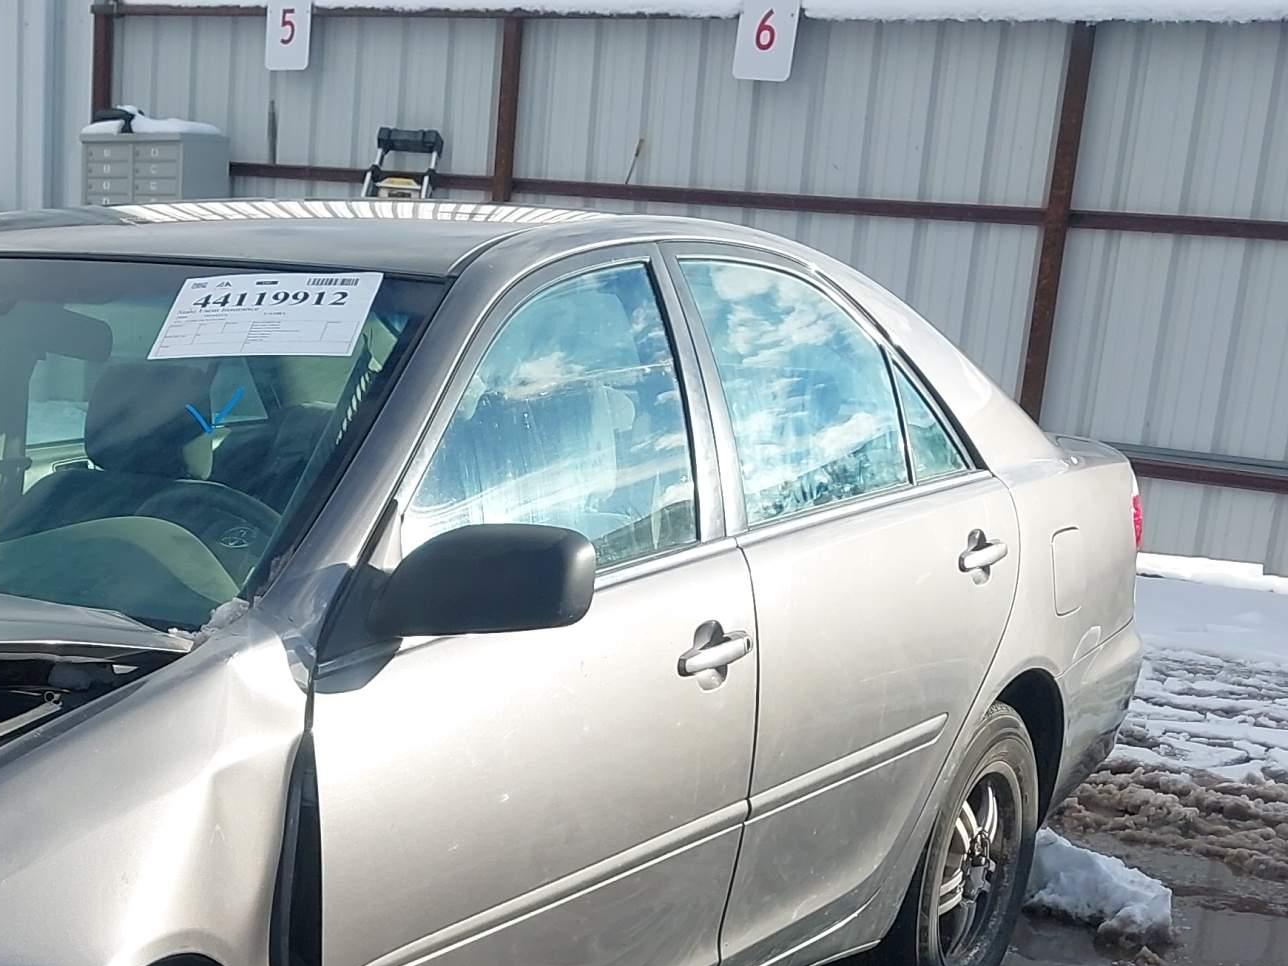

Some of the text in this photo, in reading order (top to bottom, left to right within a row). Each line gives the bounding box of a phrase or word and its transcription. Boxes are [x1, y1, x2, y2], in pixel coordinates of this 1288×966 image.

[280, 8, 295, 45] 5
[755, 8, 776, 50] 6
[192, 290, 349, 308] 44119912
